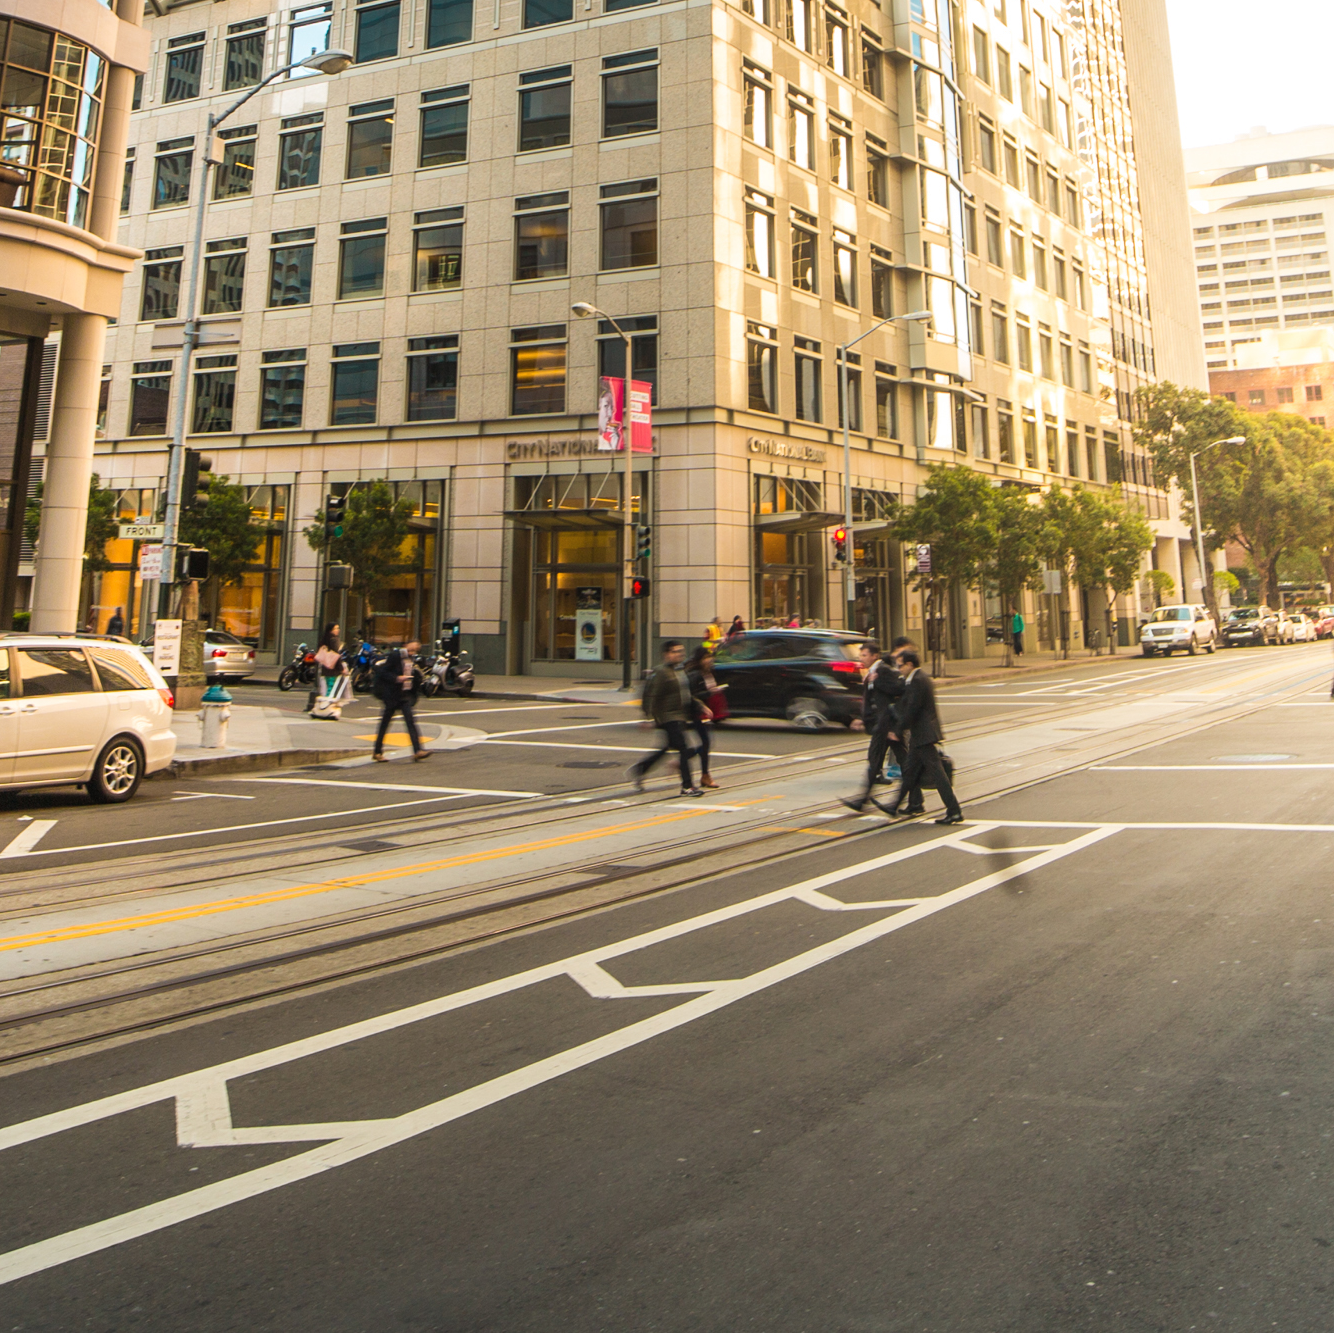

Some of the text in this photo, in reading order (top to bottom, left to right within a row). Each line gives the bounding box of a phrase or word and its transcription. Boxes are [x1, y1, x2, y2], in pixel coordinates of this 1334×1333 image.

[507, 439, 598, 459] CITY NATIONA
[126, 527, 157, 536] FRONT
